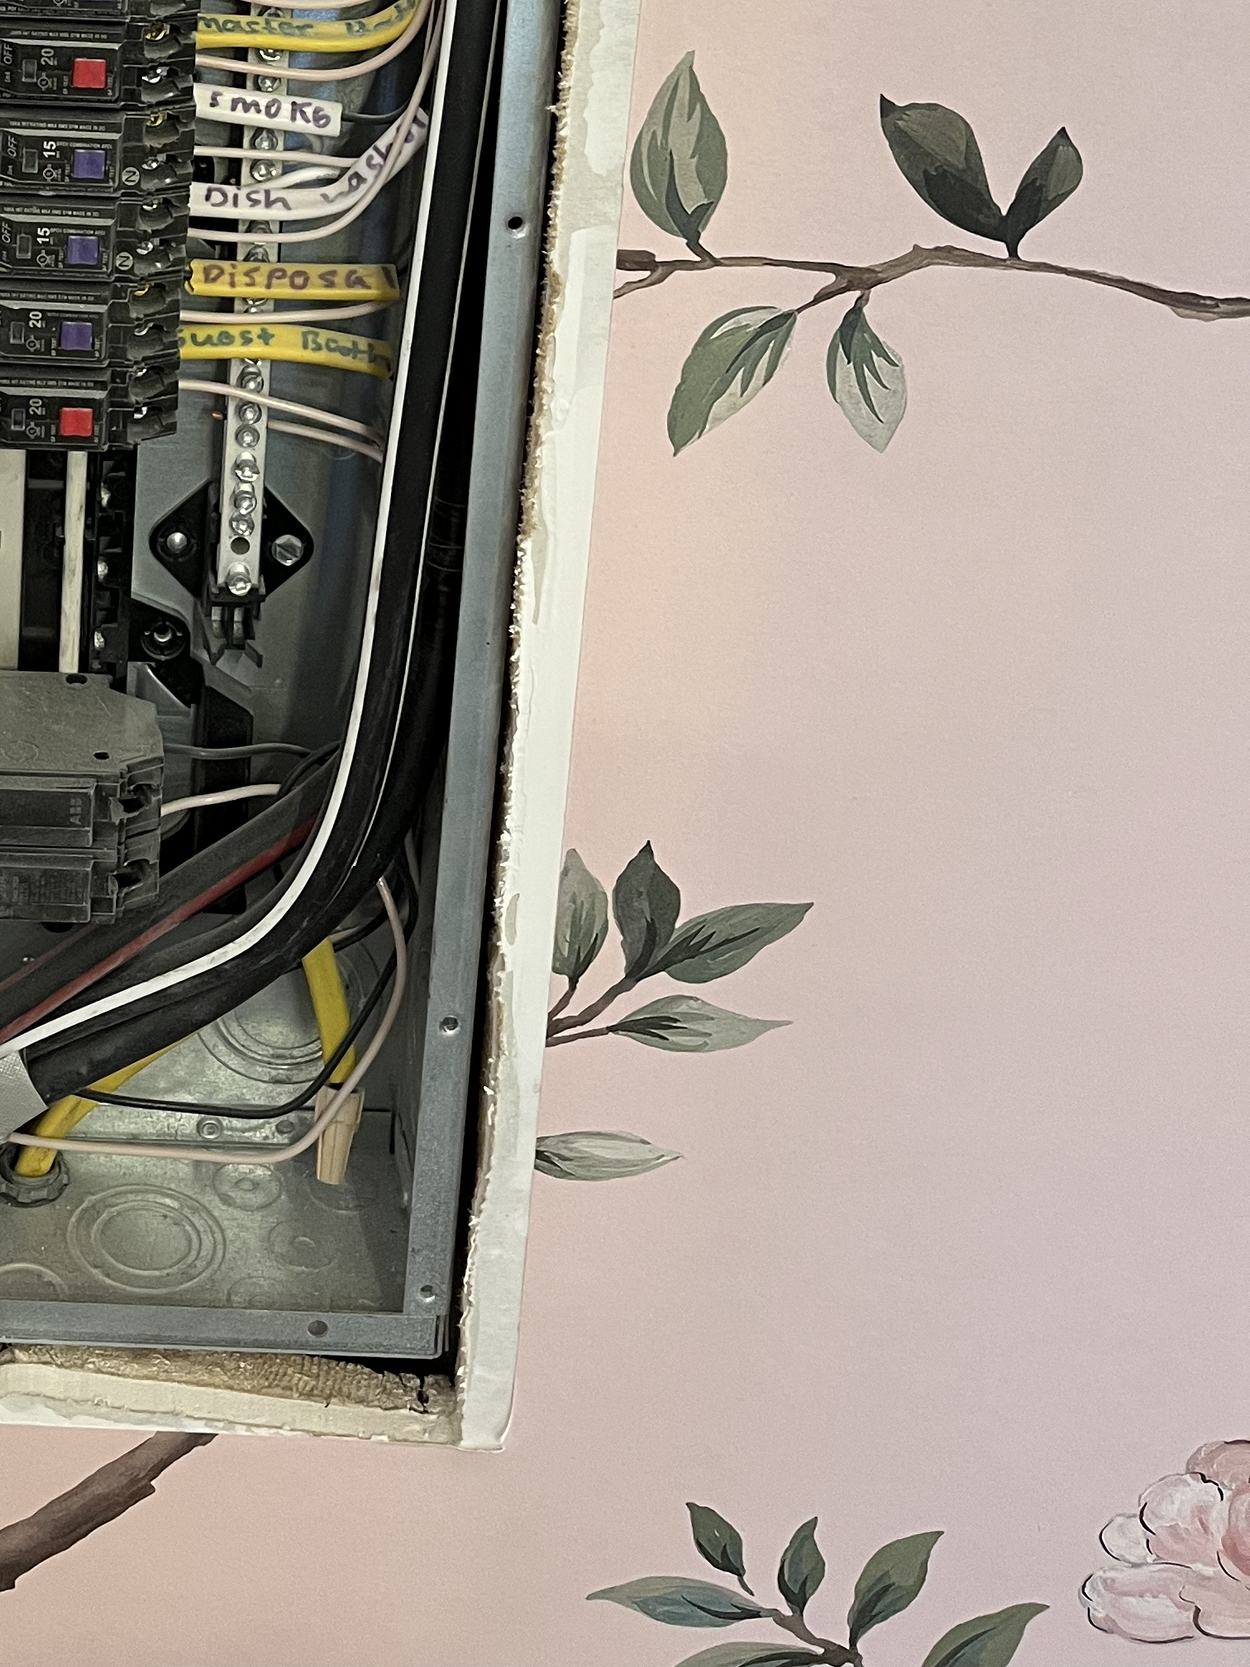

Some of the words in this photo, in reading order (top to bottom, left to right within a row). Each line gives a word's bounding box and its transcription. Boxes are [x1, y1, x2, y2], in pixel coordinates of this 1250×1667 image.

[3, 42, 13, 65] OFF
[41, 47, 54, 66] 20
[6, 135, 17, 157] OFF
[43, 141, 56, 158] 15
[204, 185, 292, 211] Dish
[1, 221, 11, 244] OFF
[36, 227, 50, 245] 15
[29, 311, 42, 329] 20
[29, 398, 42, 415] 20
[69, 798, 82, 825] ABB
